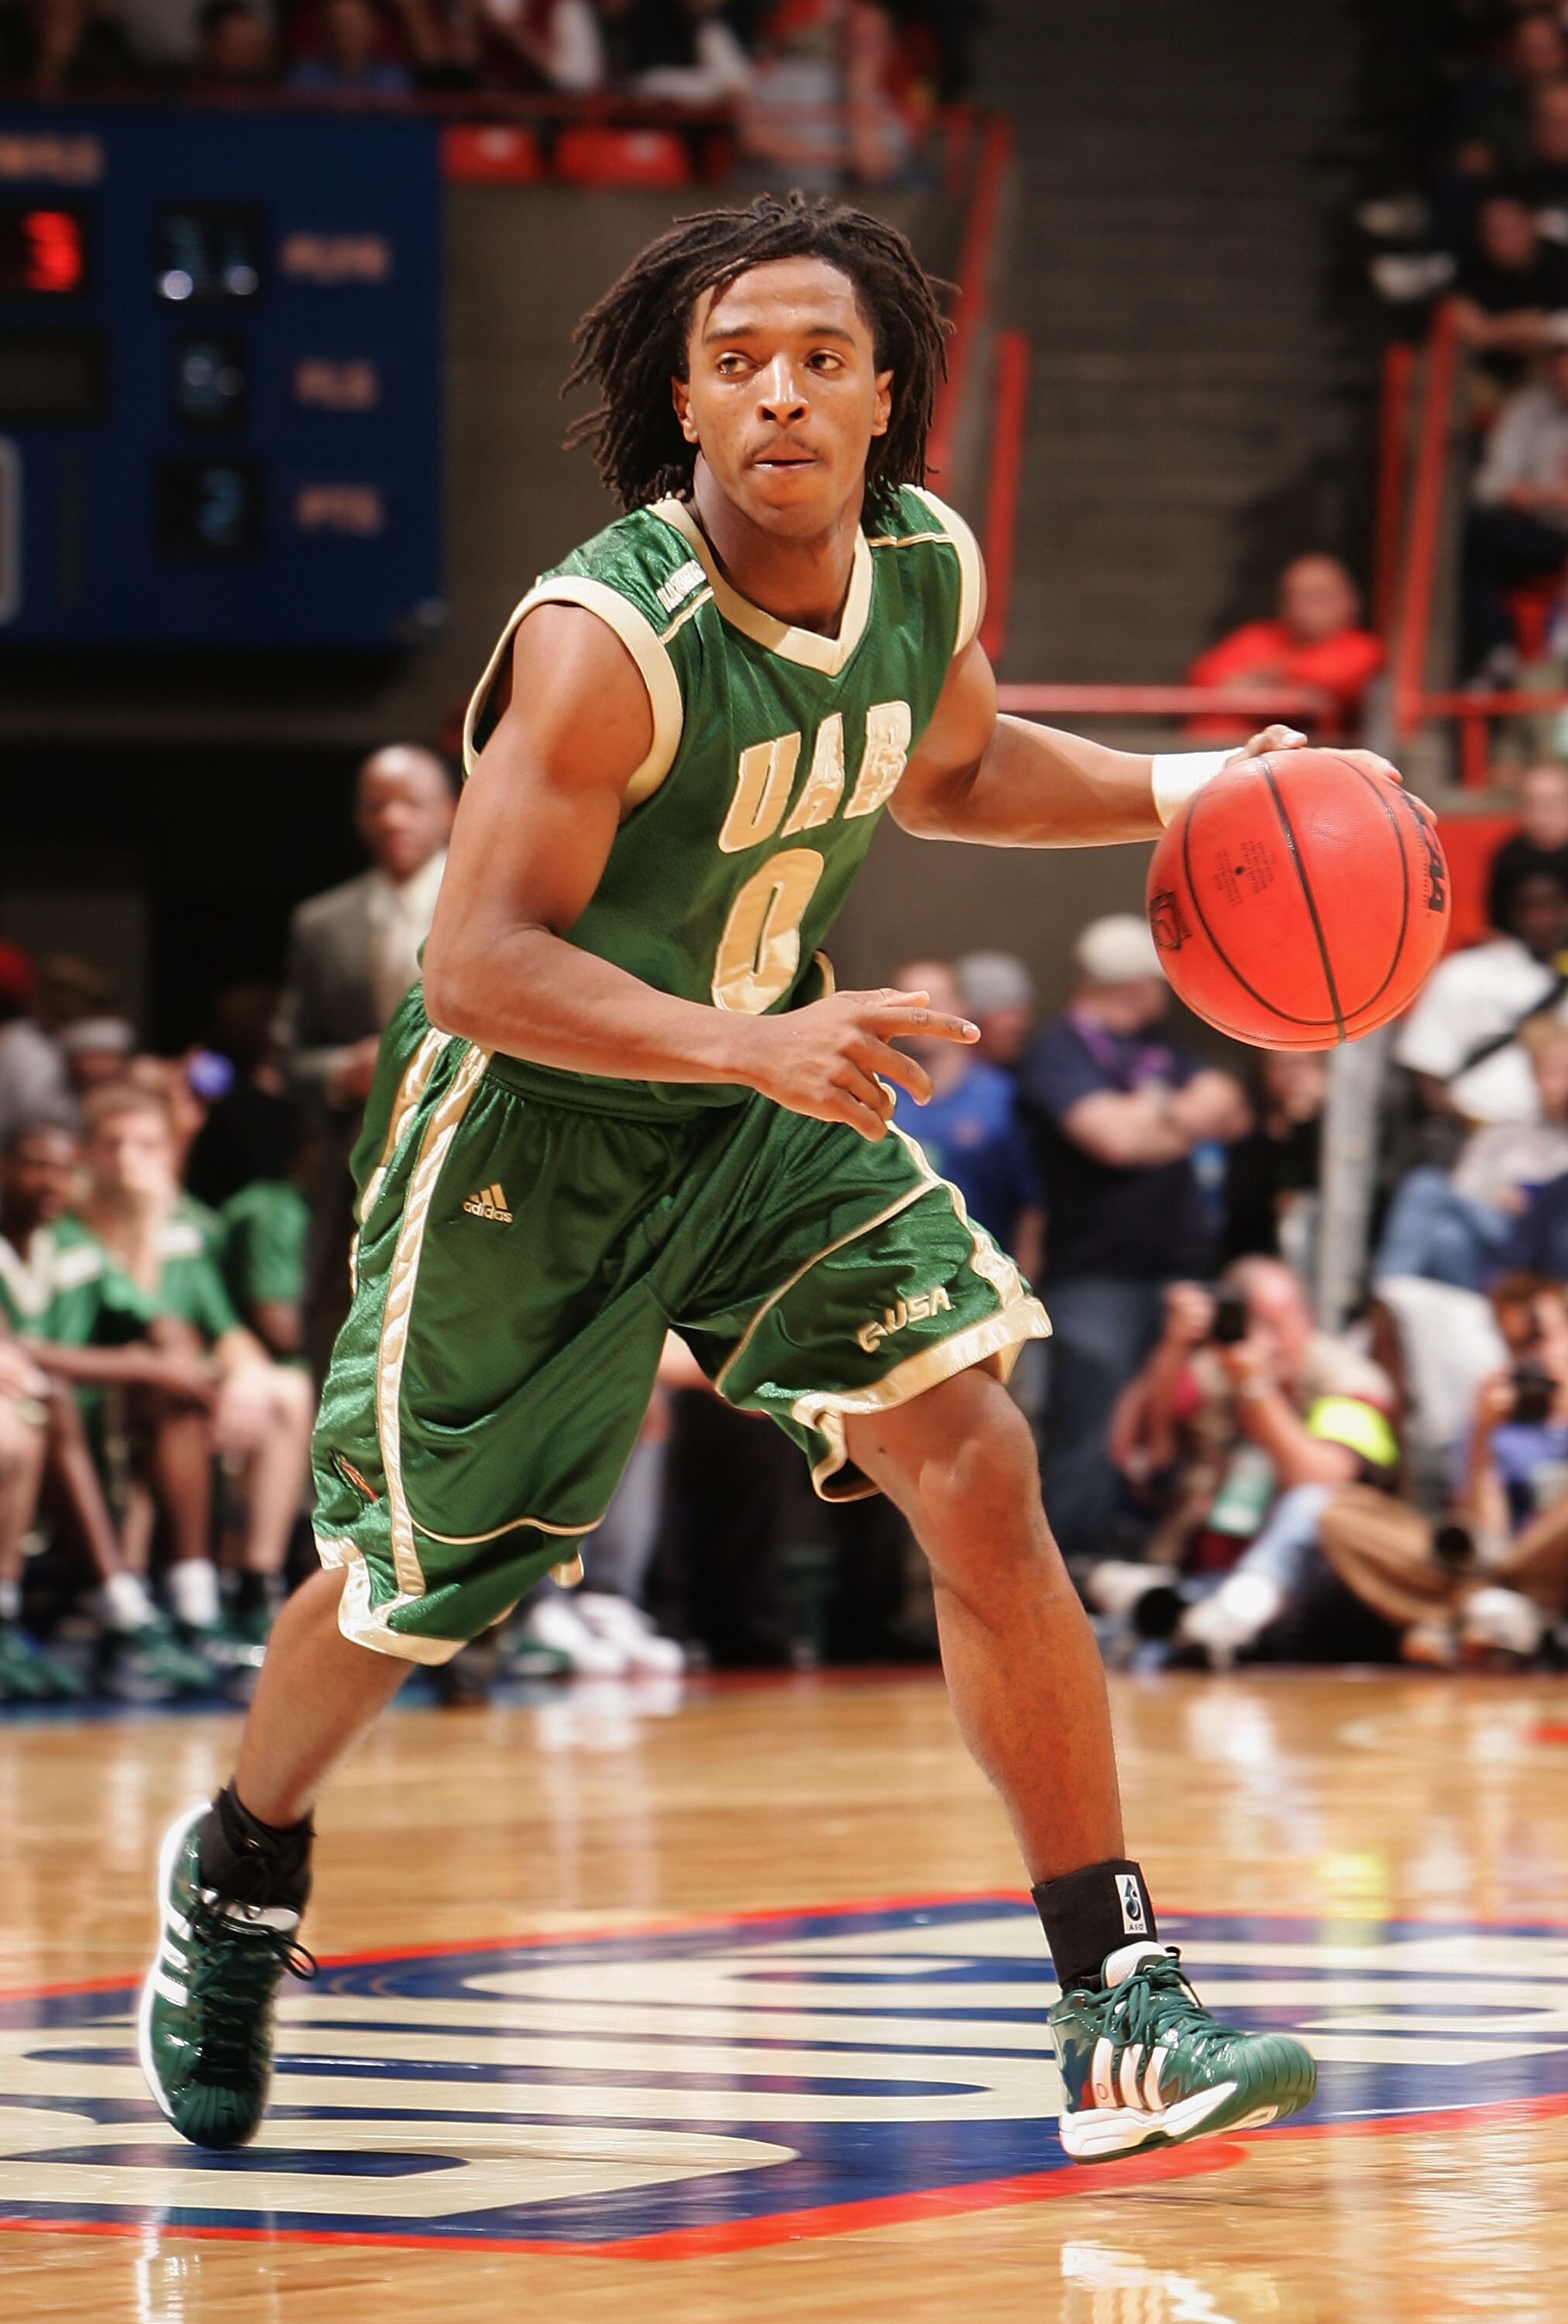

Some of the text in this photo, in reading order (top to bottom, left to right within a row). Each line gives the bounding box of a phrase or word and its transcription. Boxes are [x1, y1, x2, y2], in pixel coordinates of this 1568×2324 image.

[718, 700, 912, 854] UAB
[712, 847, 824, 1016] 0
[464, 1201, 513, 1224] adidas
